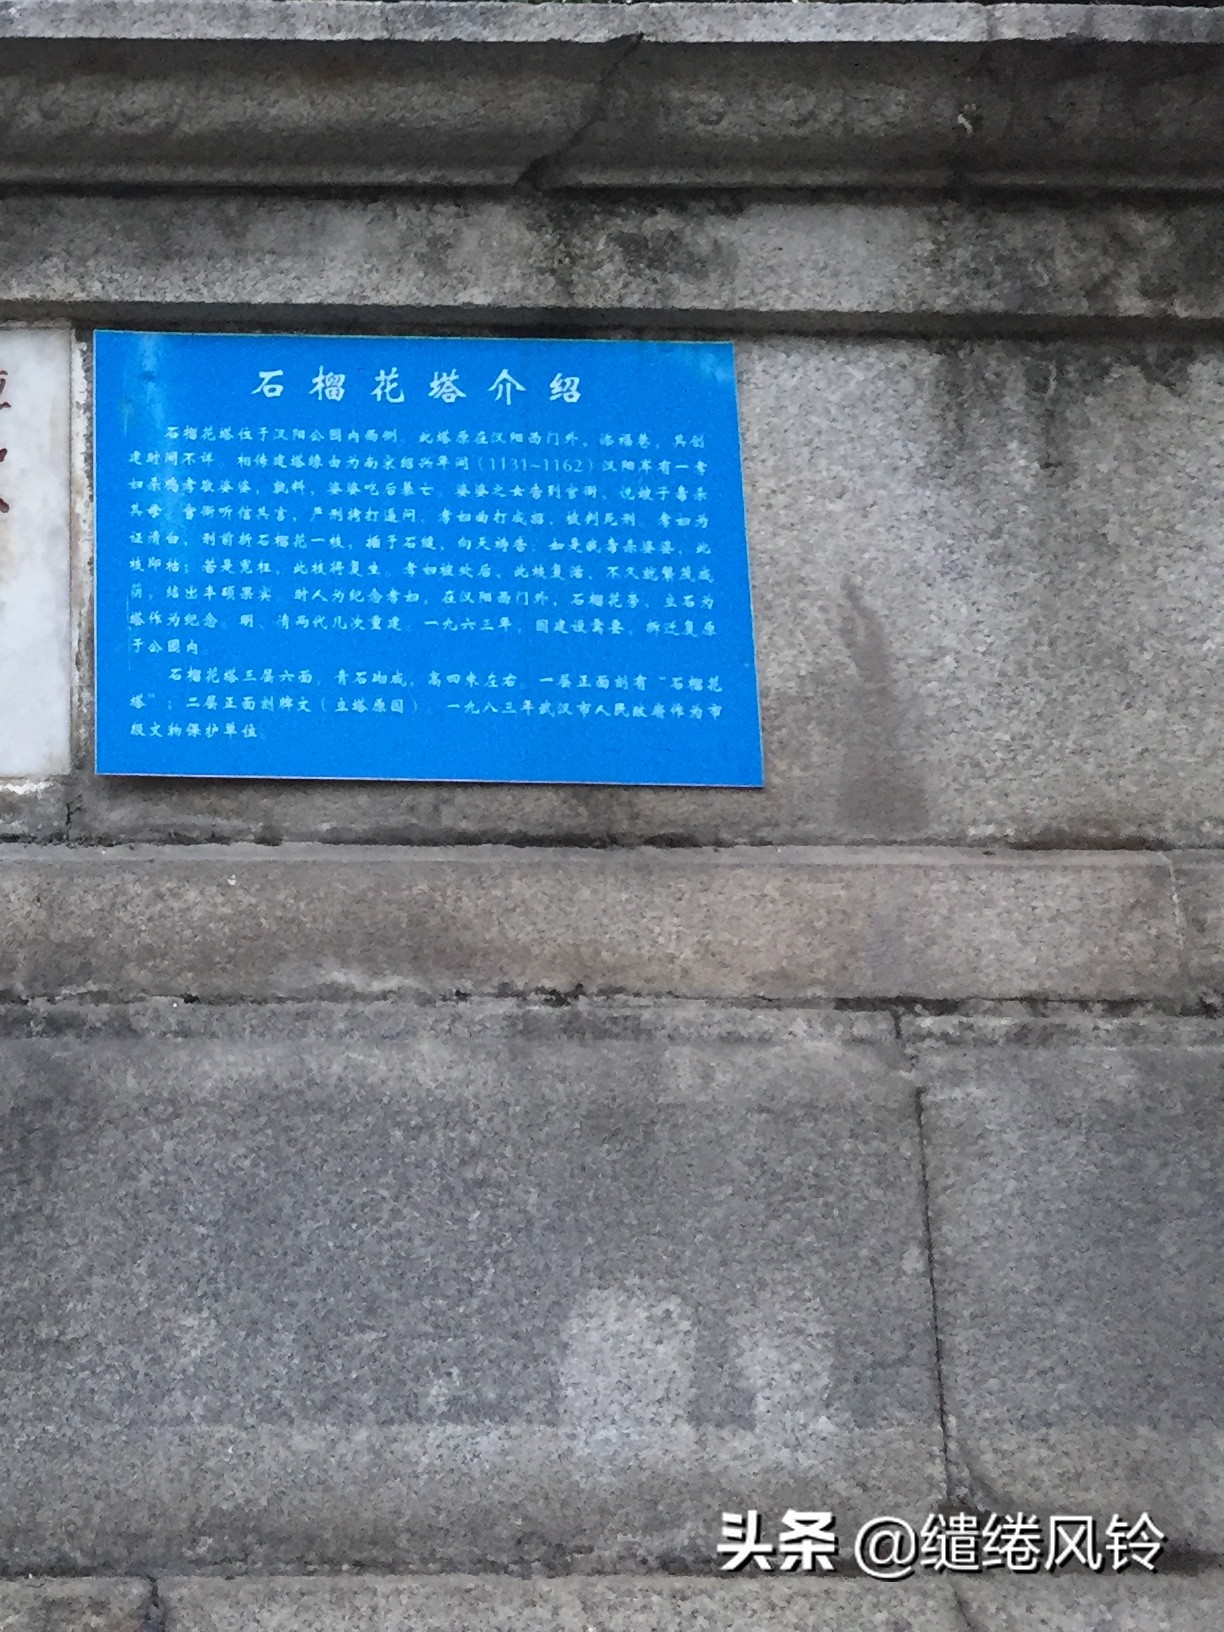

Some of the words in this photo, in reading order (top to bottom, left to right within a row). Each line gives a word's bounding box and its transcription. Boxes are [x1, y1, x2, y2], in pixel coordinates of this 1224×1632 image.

[250, 367, 584, 406] 石榴花塔介绍
